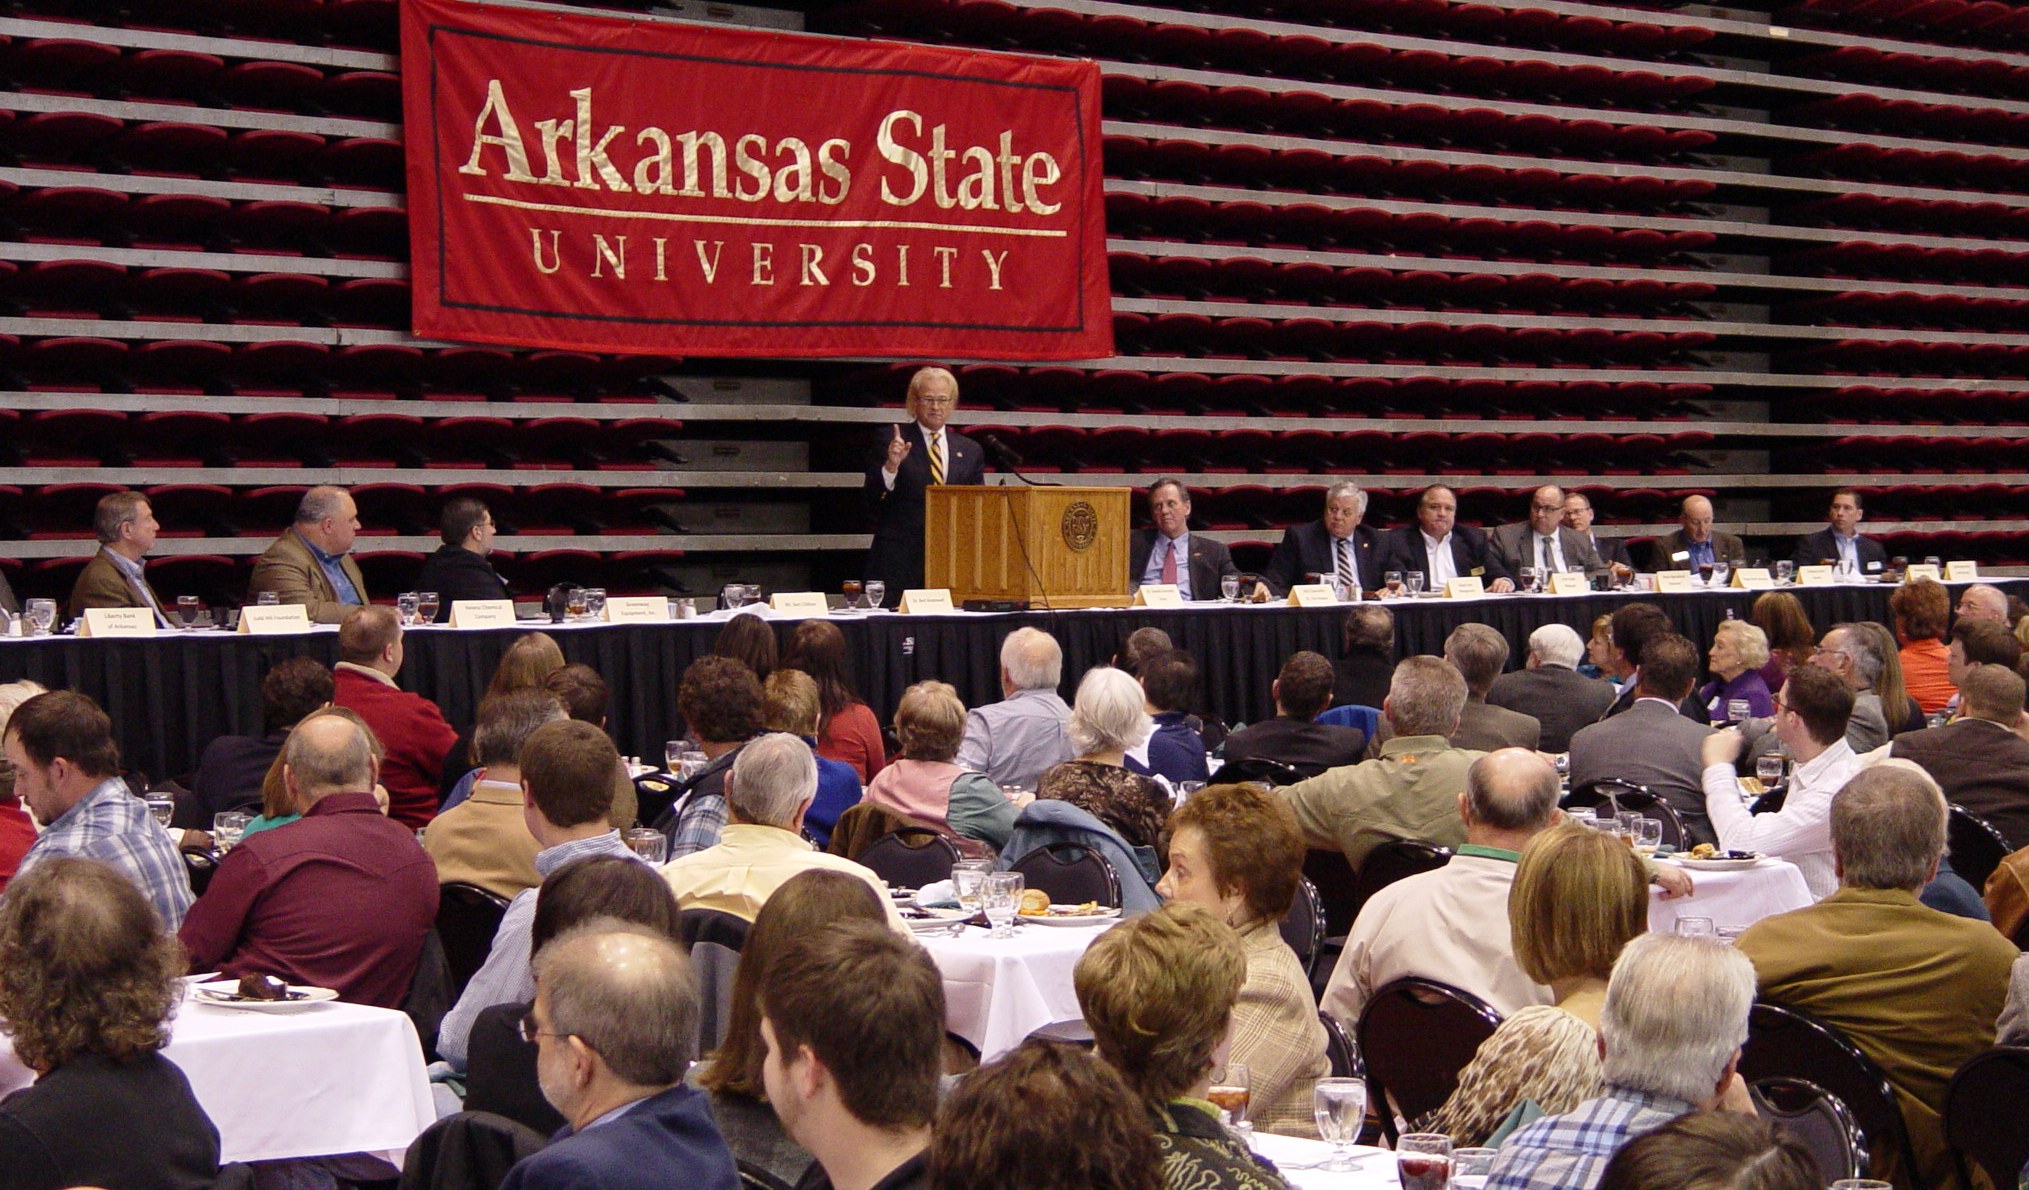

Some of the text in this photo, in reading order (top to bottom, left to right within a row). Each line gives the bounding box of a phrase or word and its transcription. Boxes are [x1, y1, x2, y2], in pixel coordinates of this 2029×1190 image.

[459, 79, 1062, 214] Arkansas State
[530, 228, 1009, 290] UNIVERSITY
